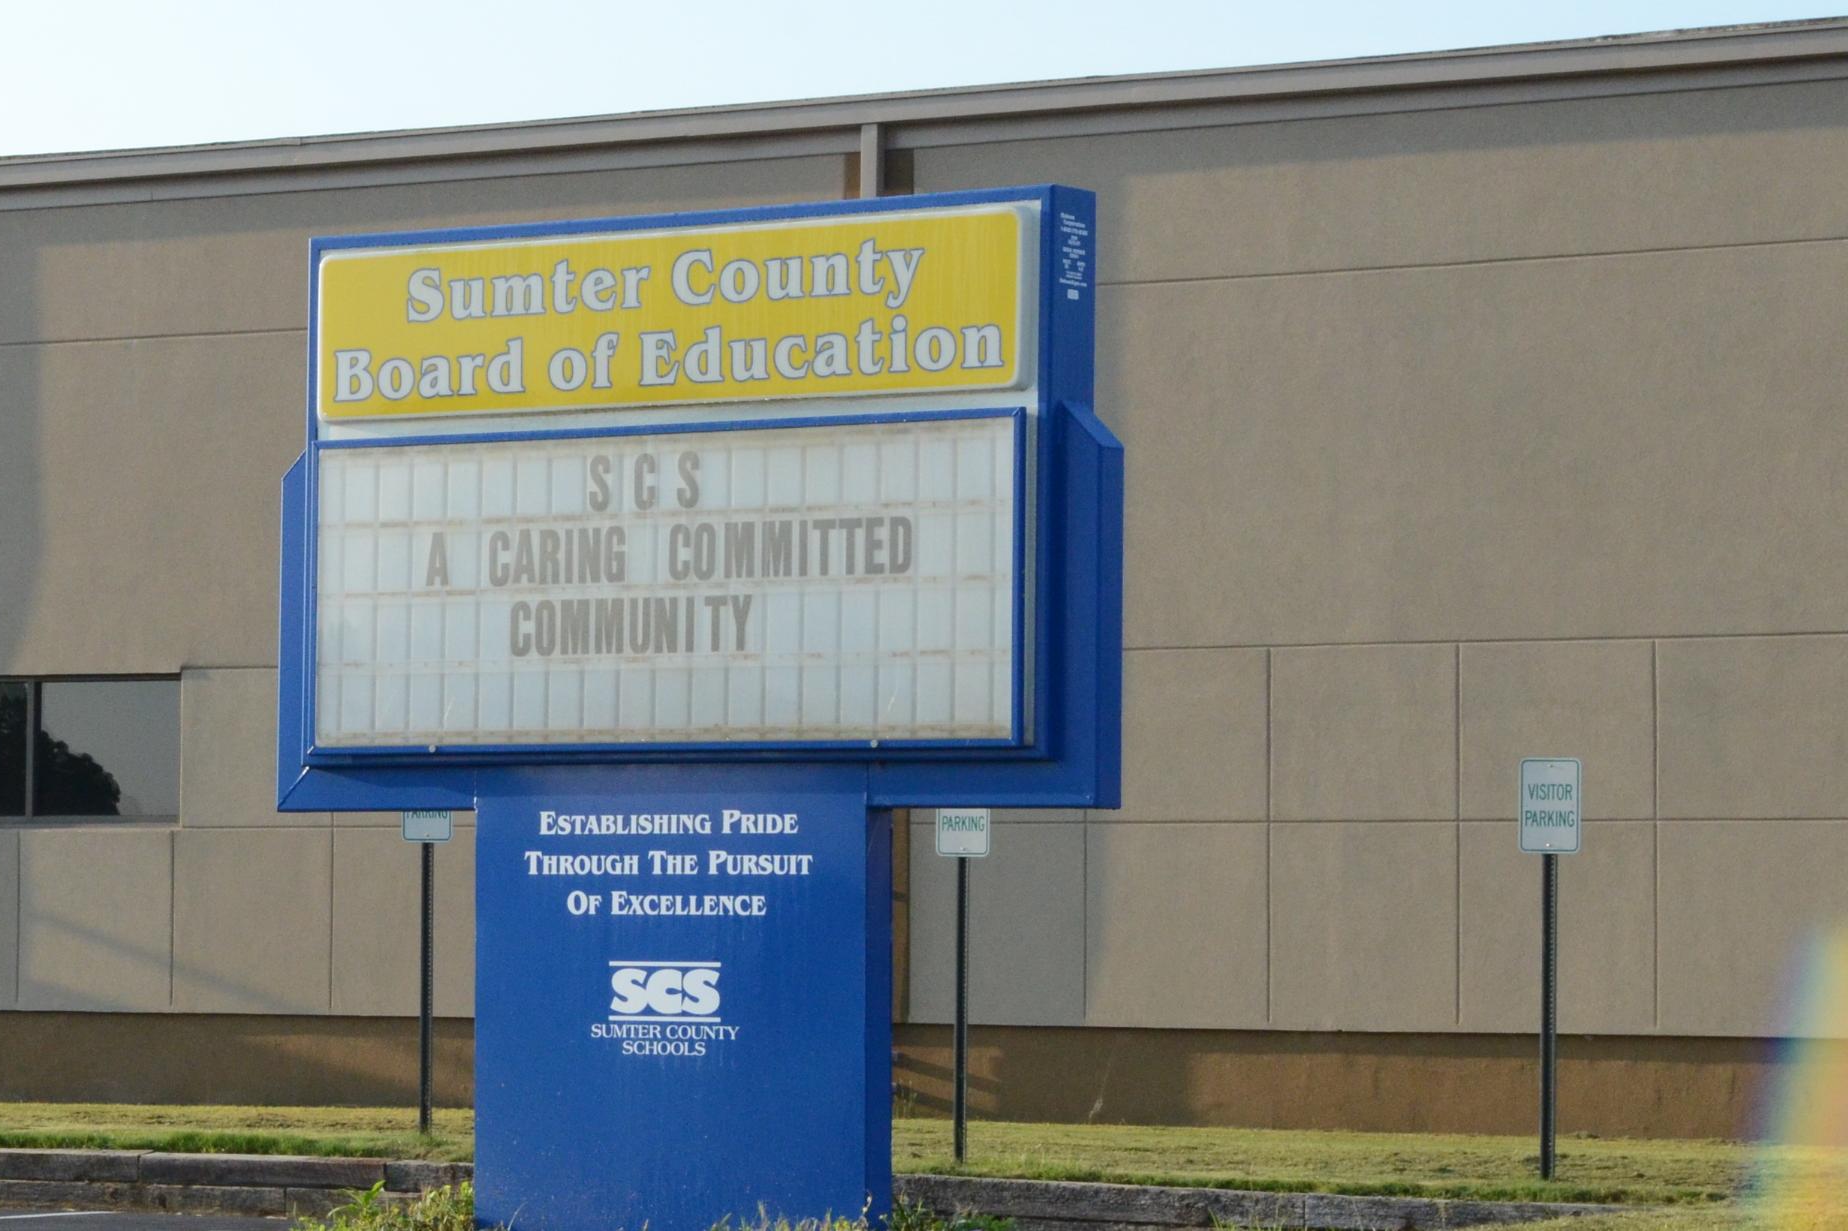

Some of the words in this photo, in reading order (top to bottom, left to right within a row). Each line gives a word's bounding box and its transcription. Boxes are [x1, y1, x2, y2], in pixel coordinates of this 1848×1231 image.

[406, 258, 652, 324] Sumter
[671, 238, 926, 310] County
[333, 336, 526, 402] Board
[548, 331, 621, 391] of
[639, 314, 1005, 386] Education
[425, 531, 449, 588] A
[488, 525, 627, 588] CARING
[668, 515, 913, 582] COMMITTED
[509, 593, 754, 658] COMMUNITY
[1527, 783, 1573, 801] VISITOR
[539, 810, 712, 836] ESTABLISHING
[721, 809, 799, 834] PRIDE
[942, 815, 985, 832] PARKING
[1524, 810, 1576, 828] PARKING
[524, 850, 639, 875] THROUGH
[647, 850, 699, 875] THE
[708, 850, 813, 875] PURSUIT
[566, 890, 602, 916] OF
[610, 890, 767, 916] EXCELLENCE
[610, 967, 721, 1016] SCS
[591, 1023, 662, 1040] SUMTER
[665, 1023, 740, 1041] COUNTY
[622, 1039, 707, 1056] SCHOOLS
